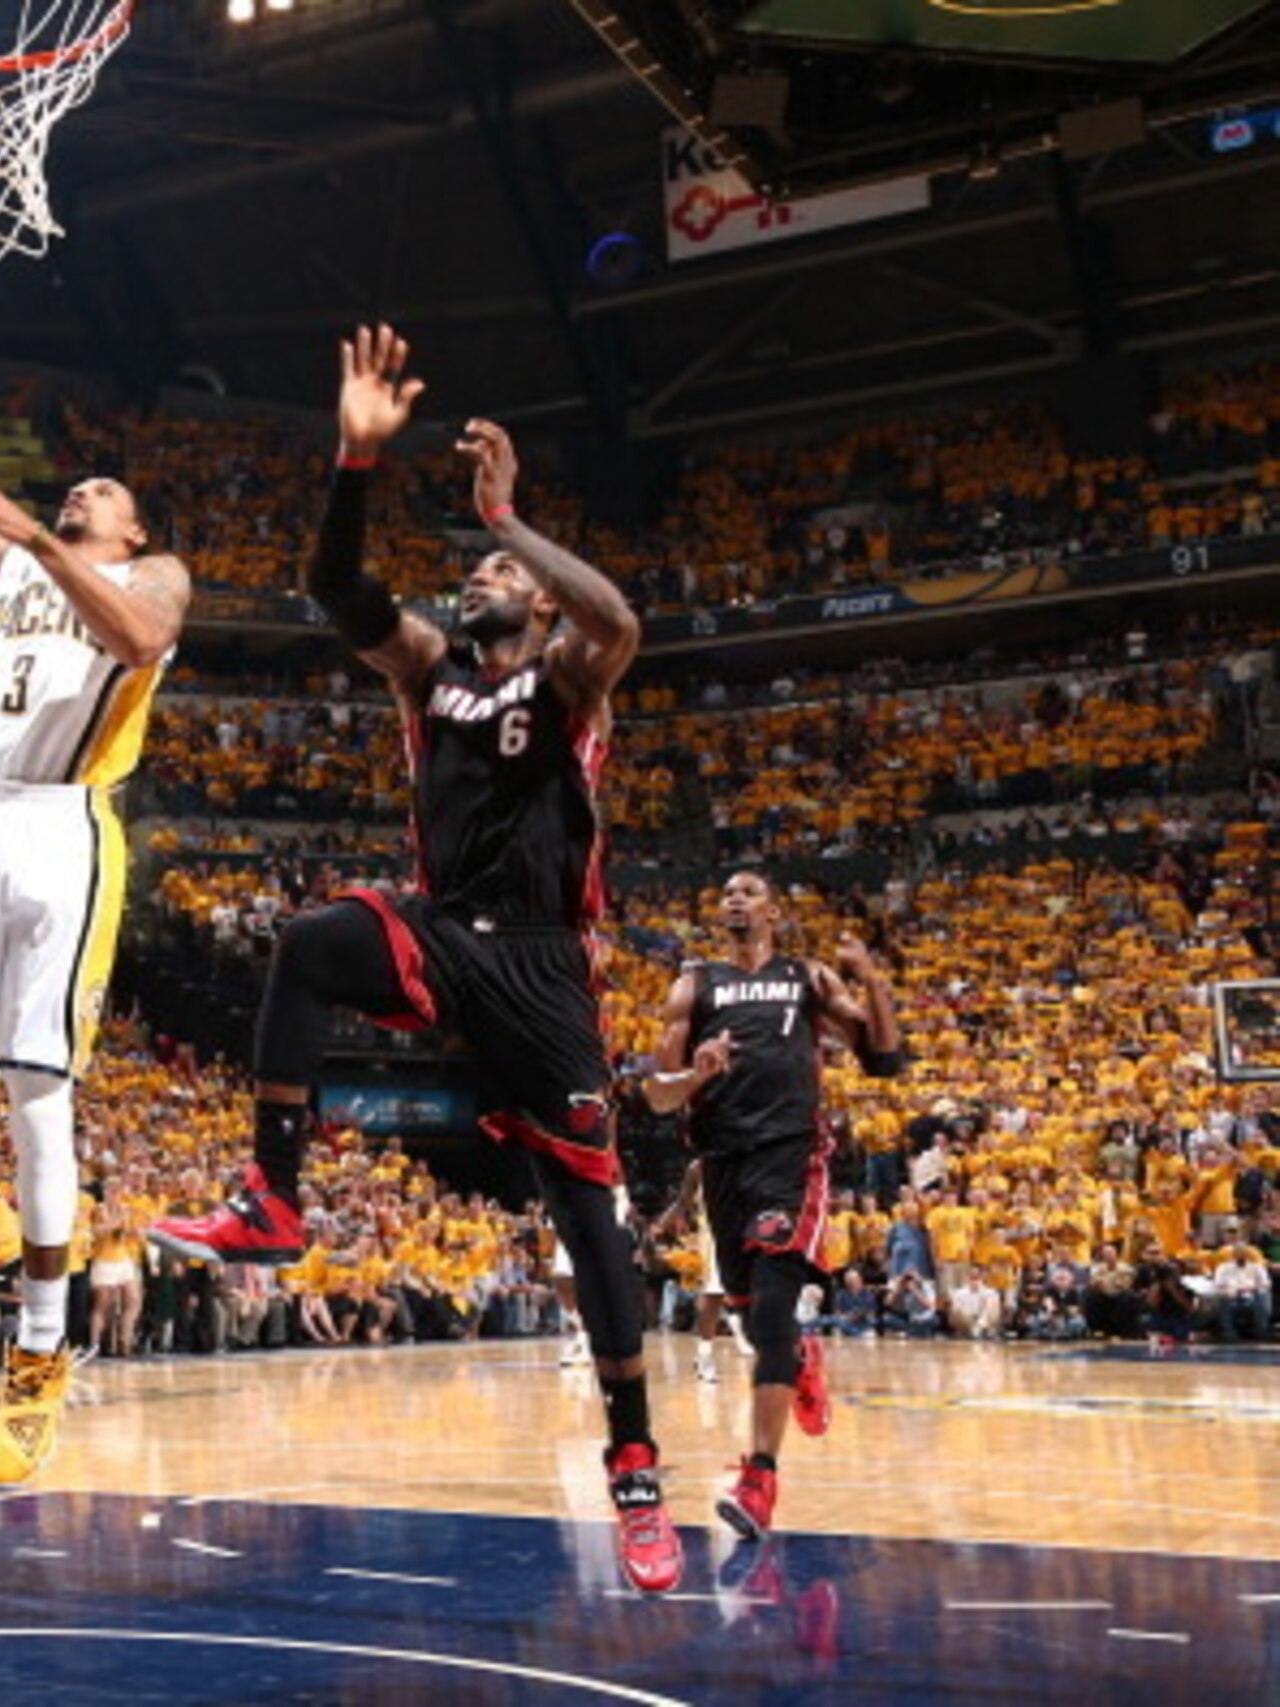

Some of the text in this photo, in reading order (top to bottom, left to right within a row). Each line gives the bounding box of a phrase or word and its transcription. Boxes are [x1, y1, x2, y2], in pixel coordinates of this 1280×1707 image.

[1171, 542, 1208, 575] 91
[1, 654, 36, 715] 3
[426, 669, 537, 721] MIAMI
[498, 706, 530, 757] 6
[714, 981, 801, 1010] MIAMI
[781, 1006, 798, 1036] 1
